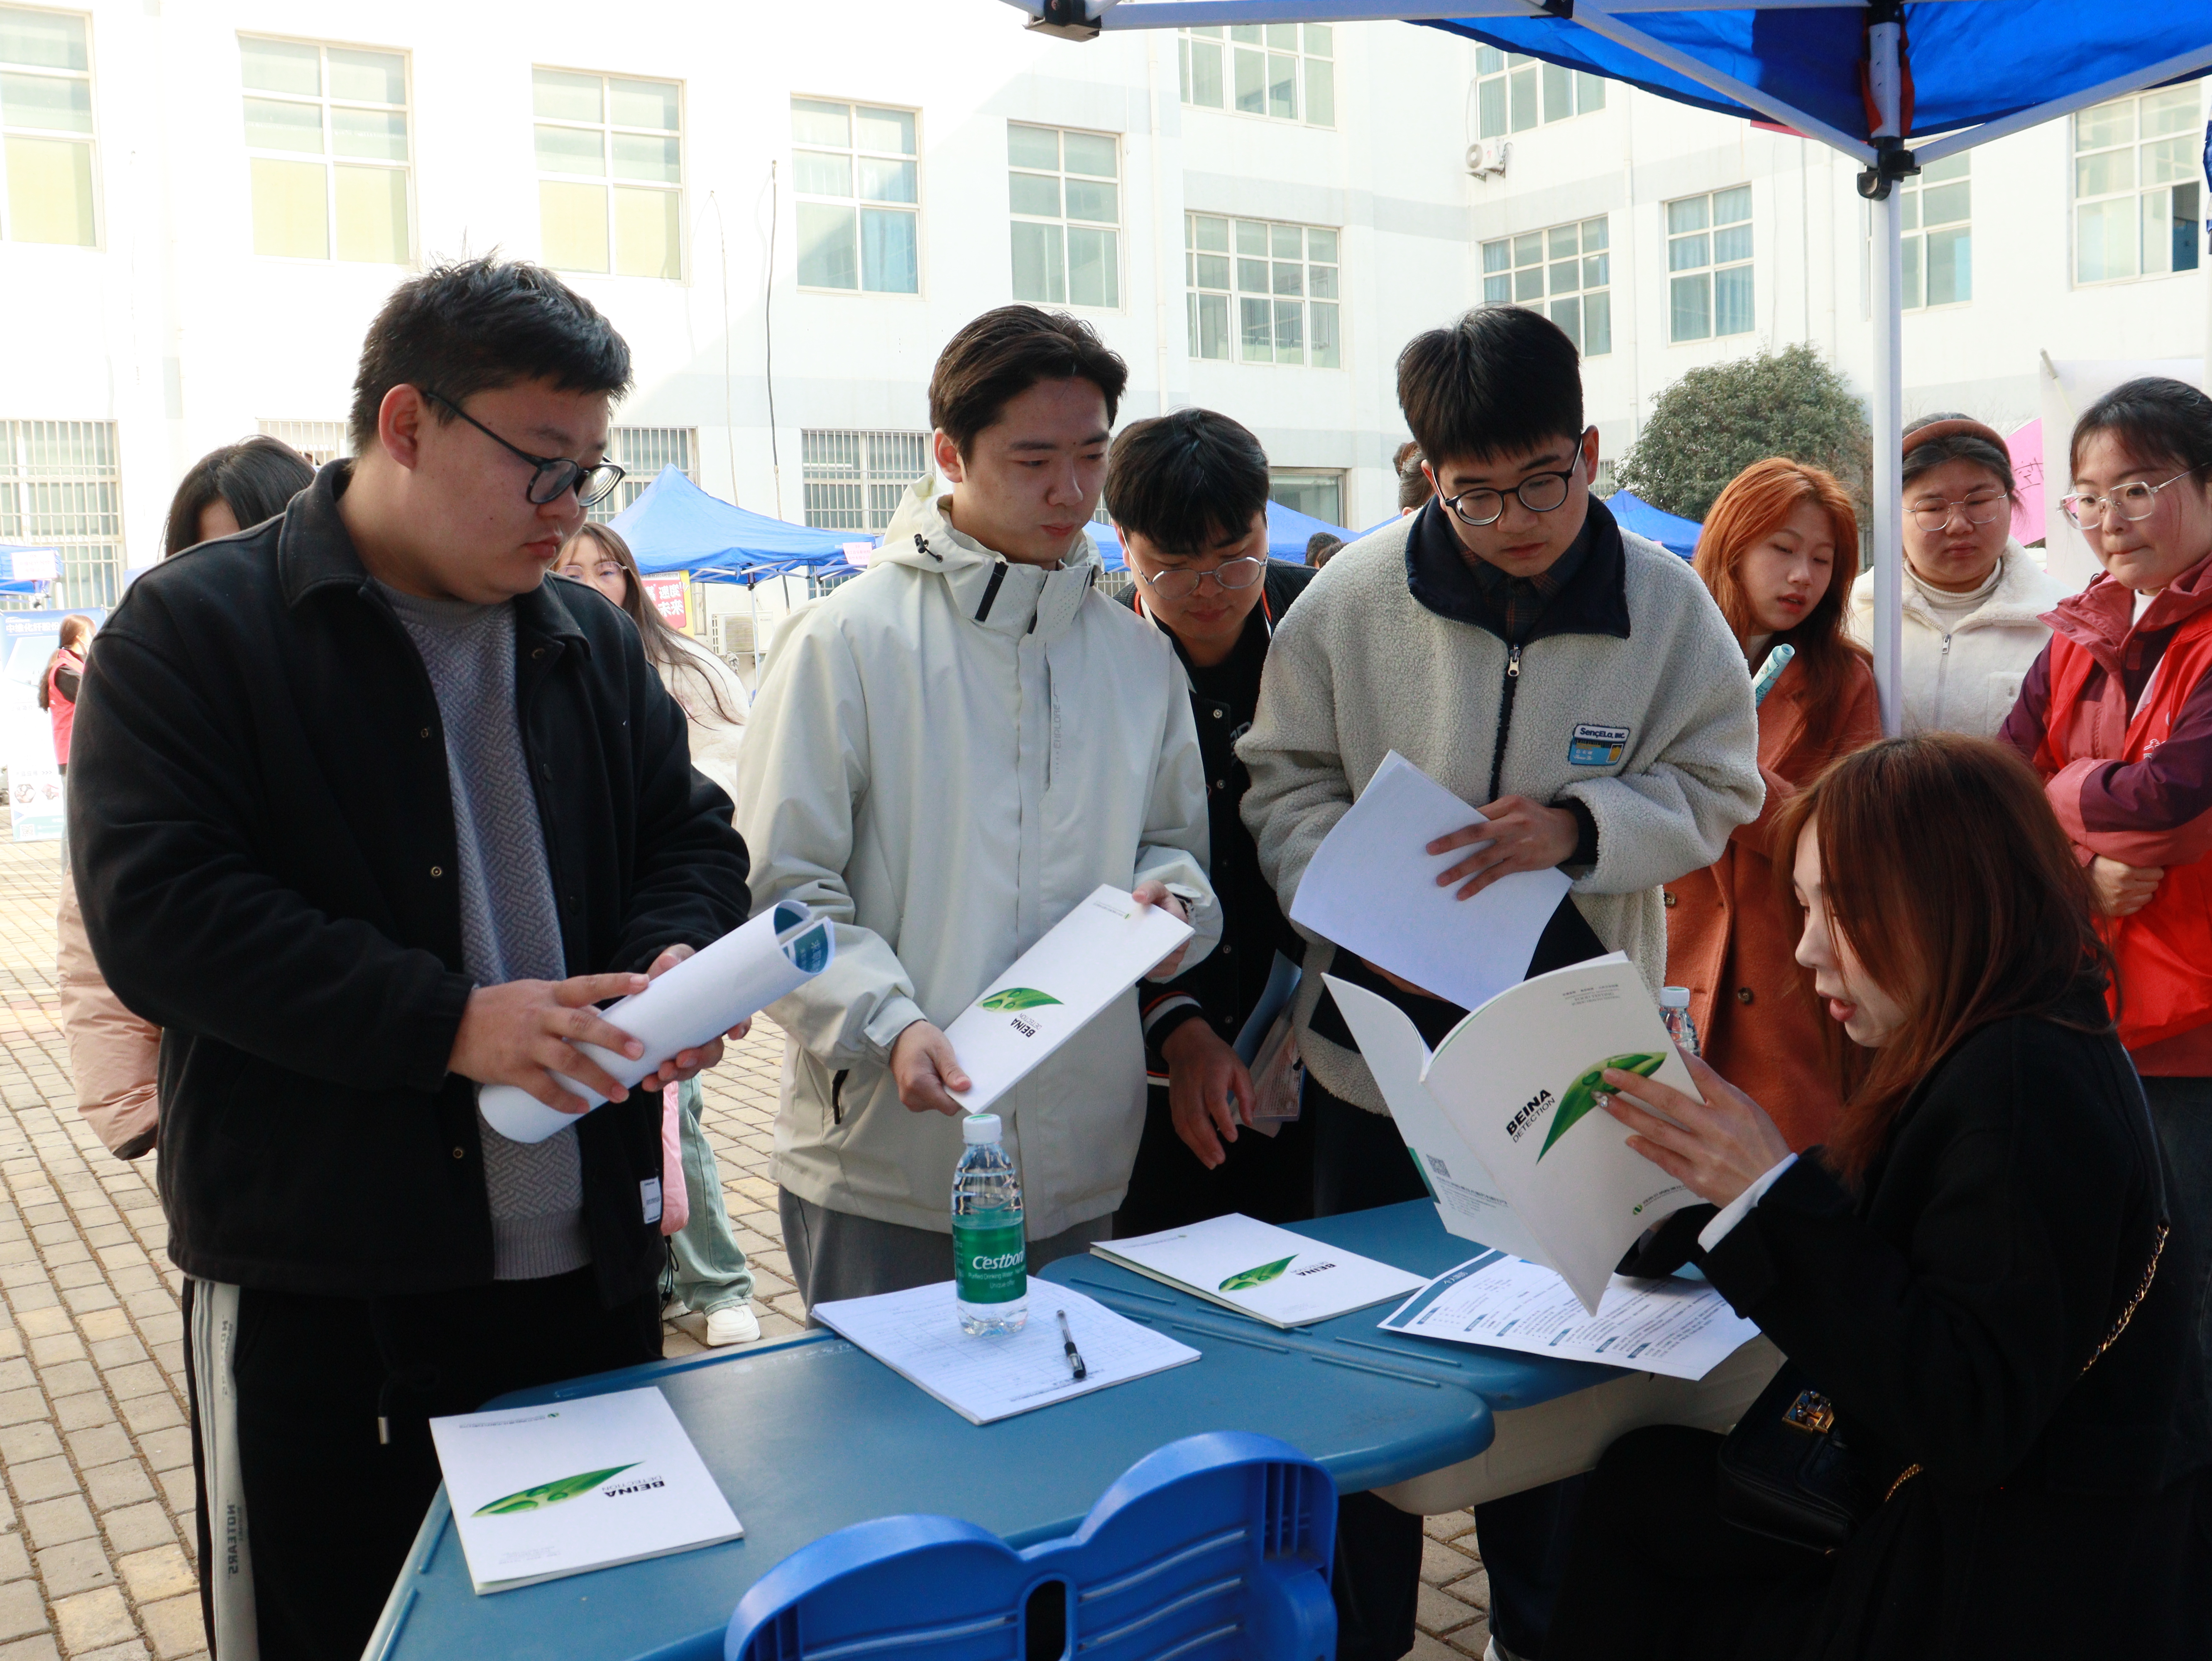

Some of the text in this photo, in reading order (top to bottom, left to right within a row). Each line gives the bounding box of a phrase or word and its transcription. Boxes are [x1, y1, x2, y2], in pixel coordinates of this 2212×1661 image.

[658, 583, 681, 600] 速度
[658, 599, 685, 617] 未来
[1010, 1018, 1036, 1038] BEINA
[1018, 1013, 1042, 1030] DETECTION
[1506, 1089, 1551, 1136] BEINA
[1512, 1098, 1555, 1143] DETECTION
[1296, 1264, 1336, 1276] BEINA
[602, 1475, 662, 1491] DETECTION
[604, 1481, 665, 1497] BEINA
